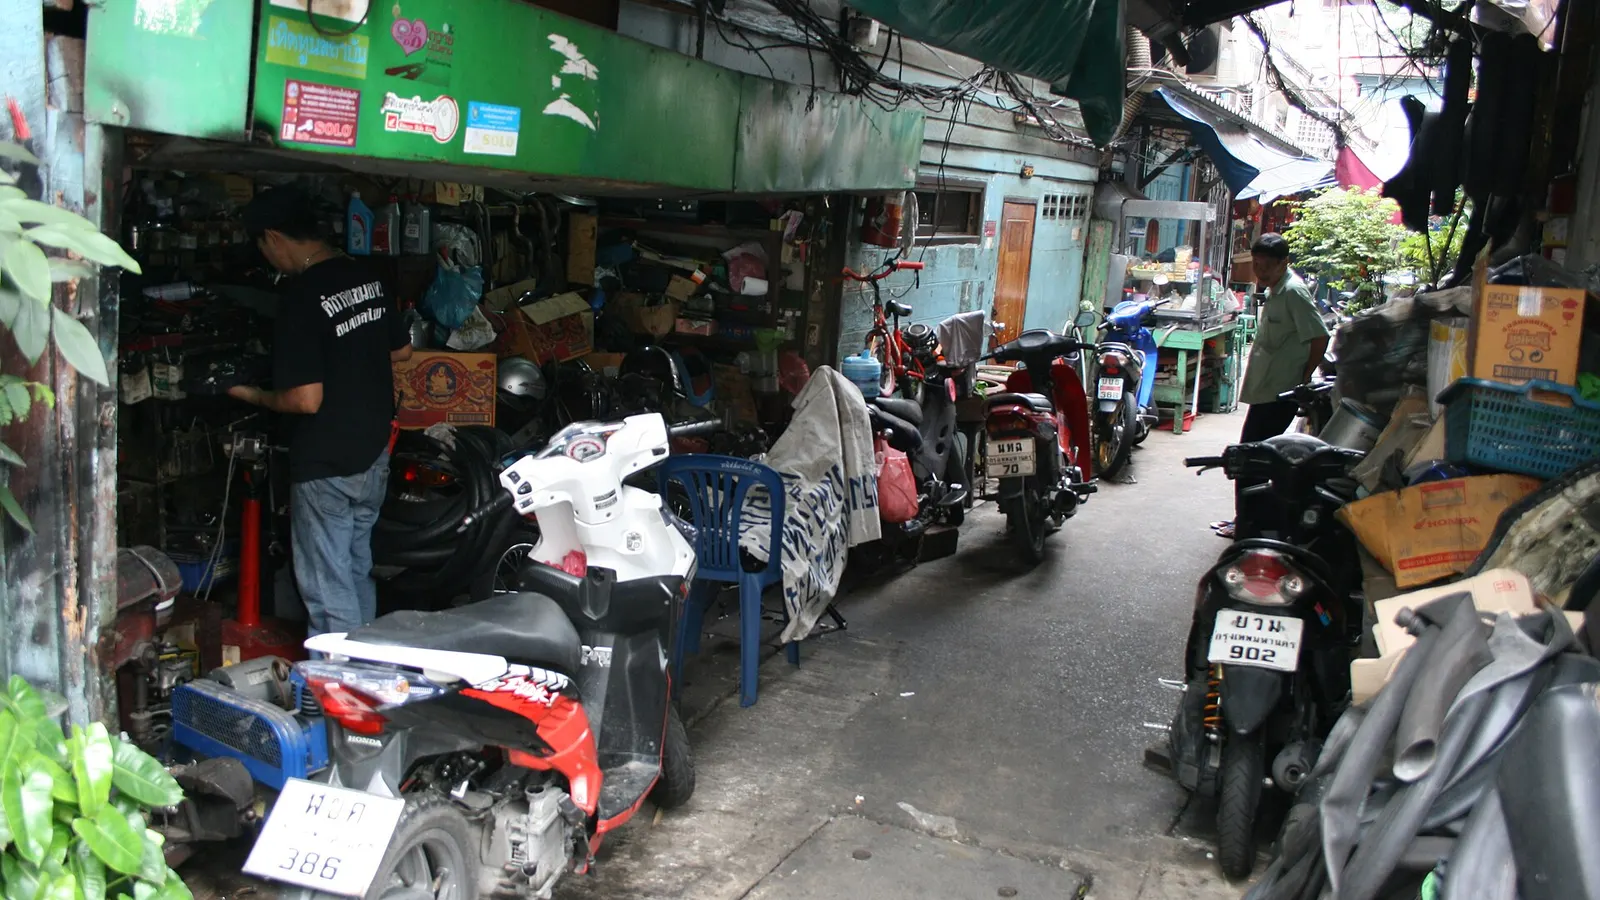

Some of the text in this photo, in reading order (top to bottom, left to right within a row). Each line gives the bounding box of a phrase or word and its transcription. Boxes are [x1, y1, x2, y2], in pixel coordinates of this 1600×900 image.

[314, 120, 353, 138] SOLO
[482, 133, 514, 148] SOLO
[1002, 463, 1019, 475] 70
[1235, 615, 1281, 633] ยาม
[1214, 631, 1297, 650] กรุงเทพมหานคร
[1229, 645, 1277, 663] 902
[347, 734, 382, 747] HONDA
[278, 847, 342, 880] 386
